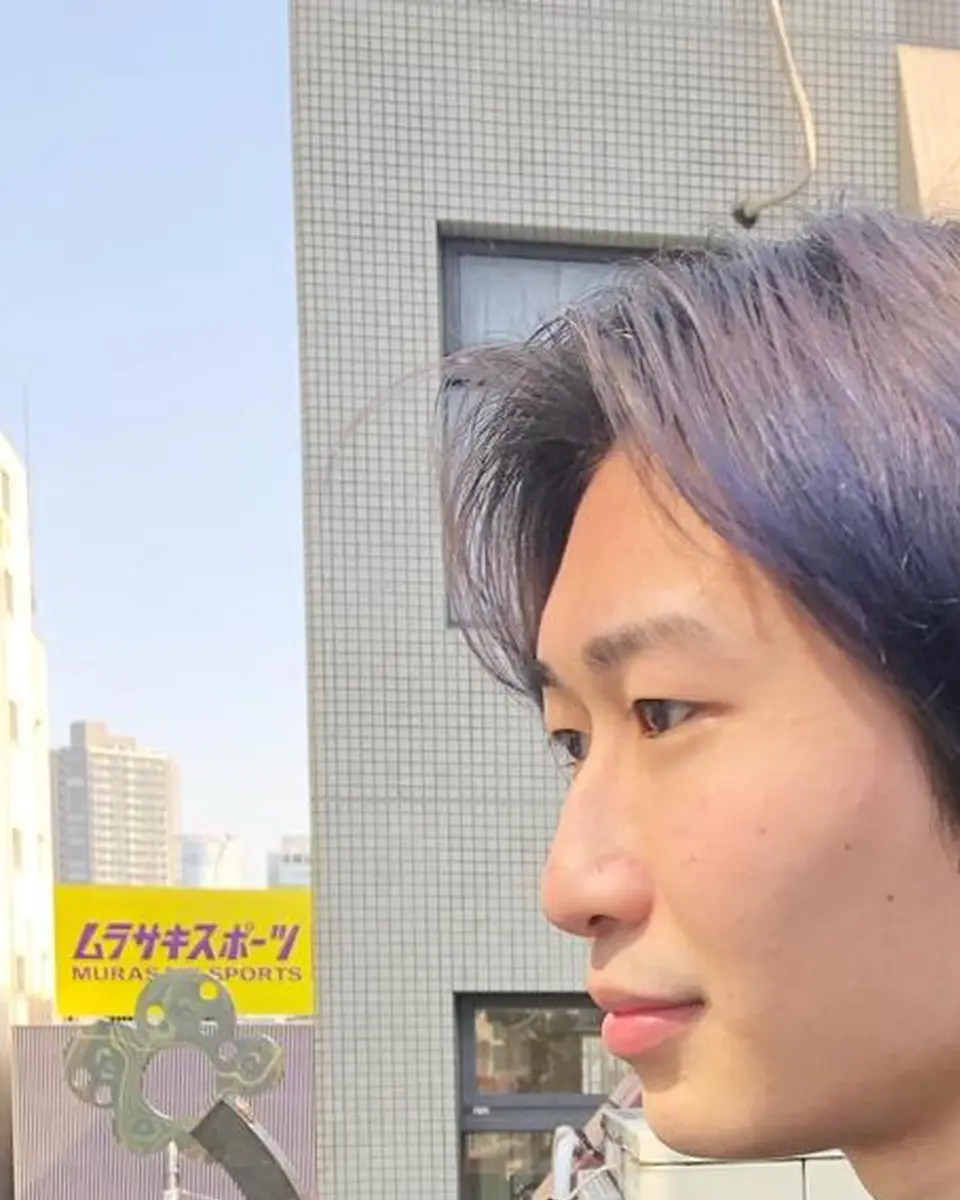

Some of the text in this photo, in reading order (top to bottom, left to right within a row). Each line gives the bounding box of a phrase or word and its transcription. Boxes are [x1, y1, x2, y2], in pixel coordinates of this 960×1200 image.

[72, 921, 300, 961] ムラサキスポーツ
[71, 966, 303, 982] MURAS SPORTS
